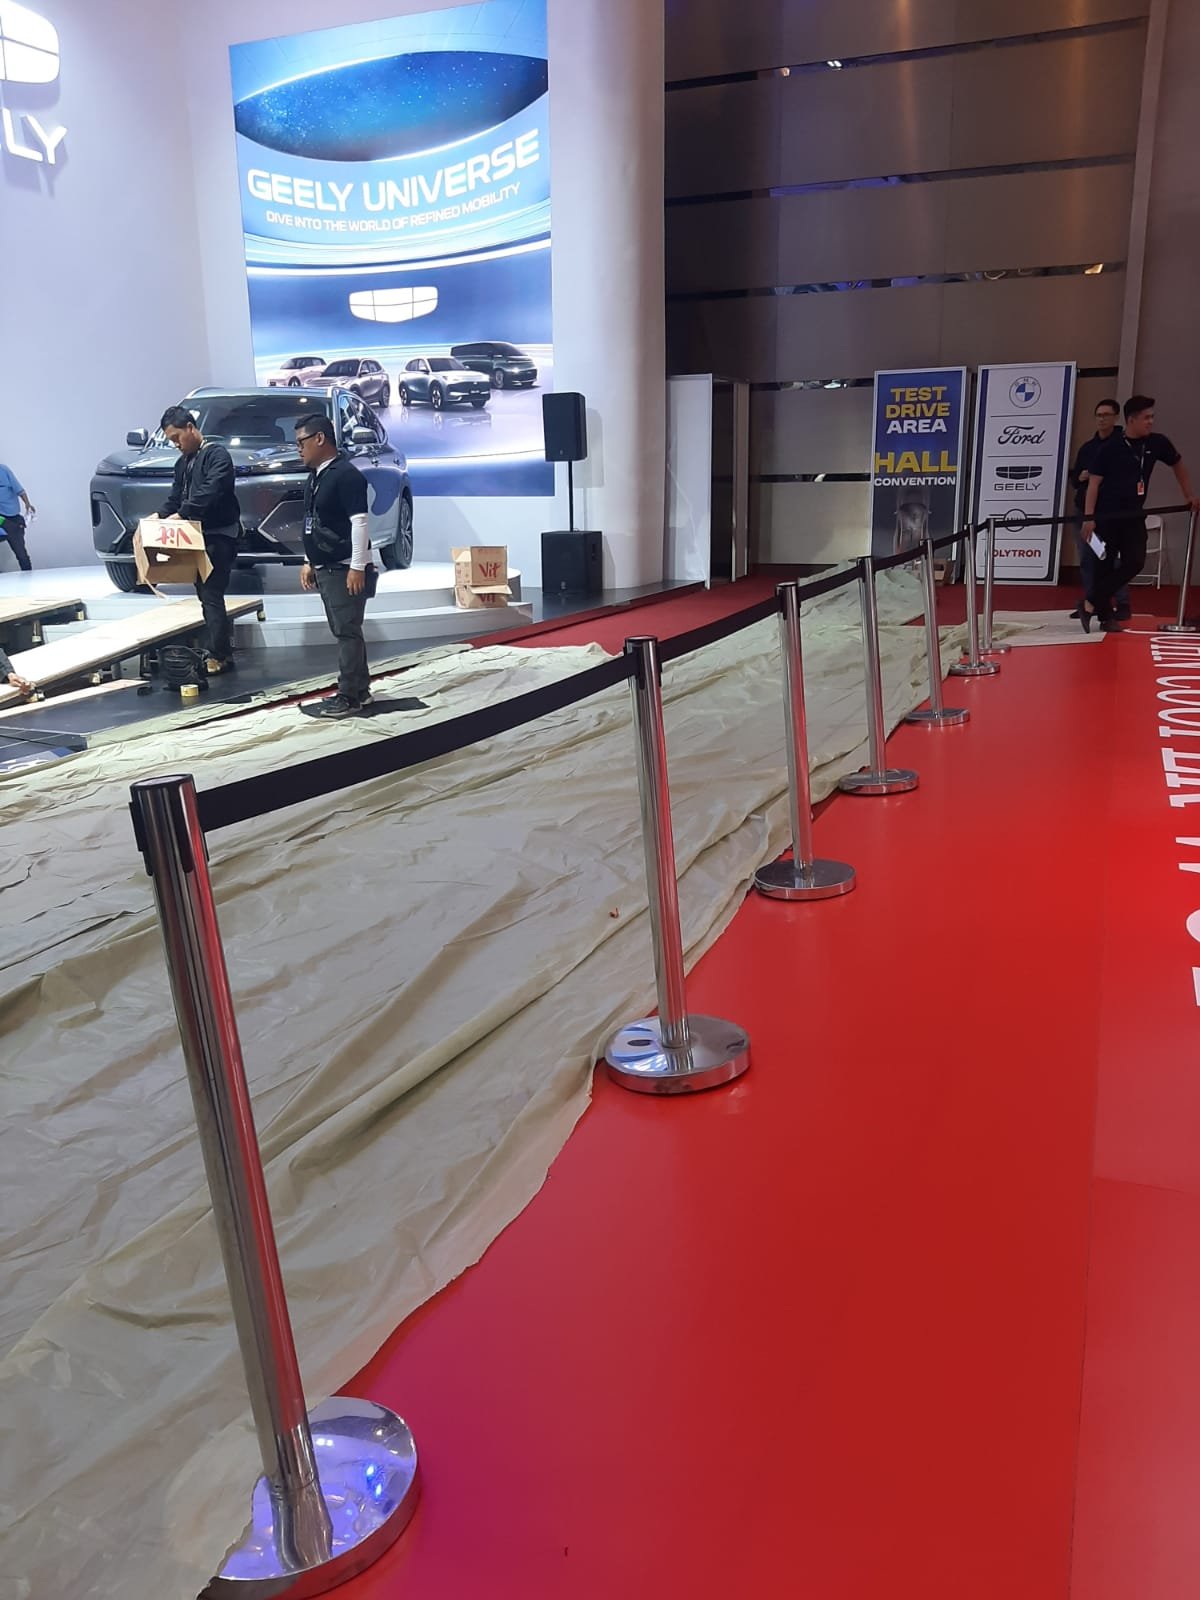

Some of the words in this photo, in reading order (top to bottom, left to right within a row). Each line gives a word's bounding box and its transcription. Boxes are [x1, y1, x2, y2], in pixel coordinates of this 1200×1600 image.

[247, 168, 354, 212] GEELY
[362, 128, 540, 212] UNIVERSE
[266, 210, 294, 226] DIVE
[294, 216, 322, 230] INTO
[324, 219, 348, 232] THE
[348, 219, 391, 232] WORLD
[391, 216, 409, 230] OF
[409, 205, 460, 227] REFINED
[461, 181, 521, 215] MOBILITY
[890, 386, 947, 402] TEST
[885, 402, 950, 418] DRIVE
[886, 418, 947, 434] AREA
[997, 425, 1046, 445] Ford
[875, 451, 957, 473] HALL
[874, 476, 956, 487] CONVENTION
[994, 483, 1041, 491] GEELY
[155, 526, 193, 547] Vit
[992, 549, 1041, 558] OLYTRON
[478, 561, 502, 579] Vit
